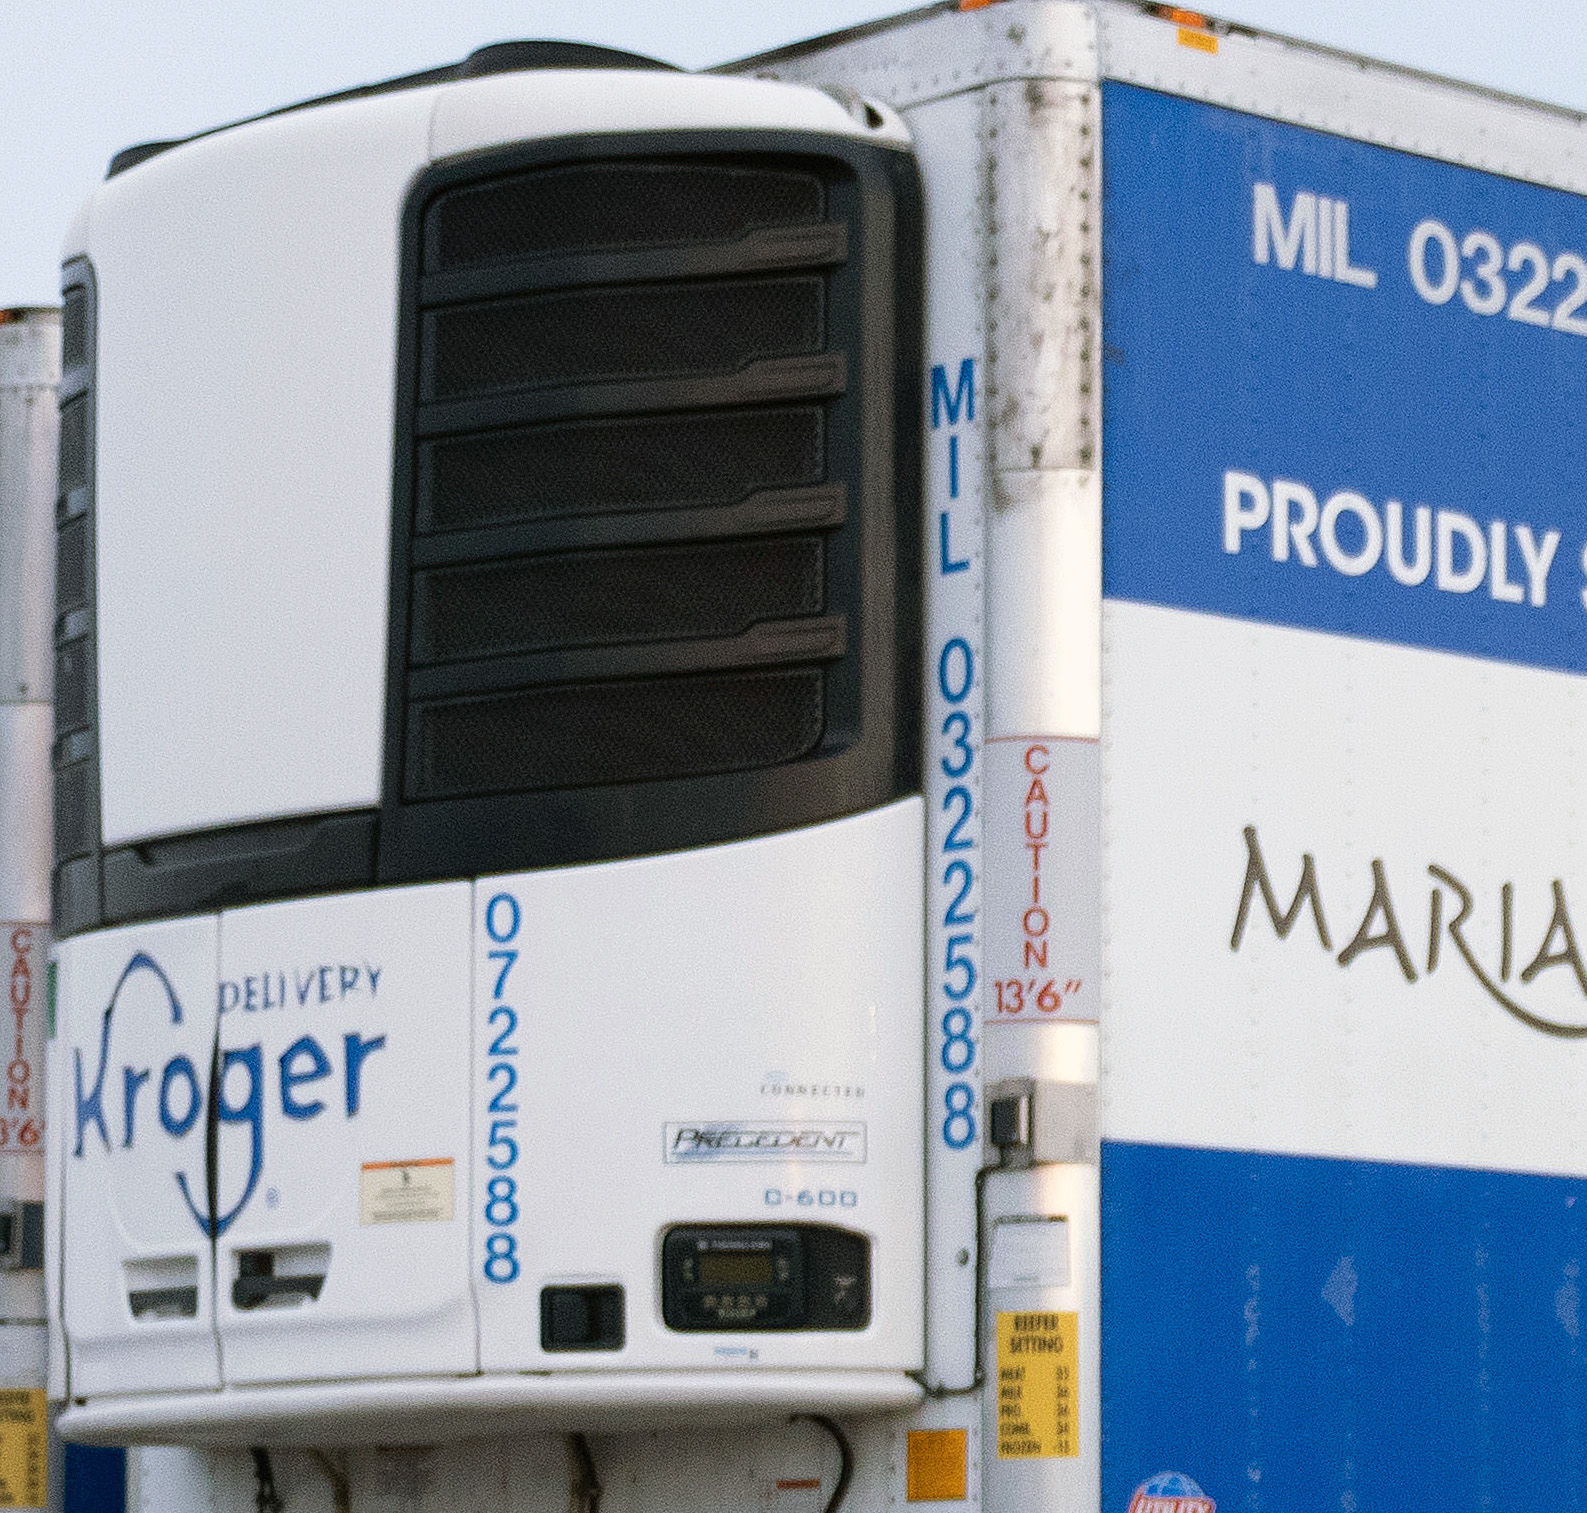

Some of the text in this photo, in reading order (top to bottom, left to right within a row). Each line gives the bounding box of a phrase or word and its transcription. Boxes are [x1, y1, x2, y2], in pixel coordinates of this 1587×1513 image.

[1252, 181, 1377, 289] MIL
[1222, 470, 1561, 608] PROUDLY
[931, 358, 977, 1150] MIL 0322588
[1023, 745, 1050, 969] CAUTION
[7, 928, 31, 1110] CAUTION
[219, 965, 381, 1014] DELIVERY
[484, 892, 521, 1284] 0722588
[73, 950, 386, 1240] Kroger
